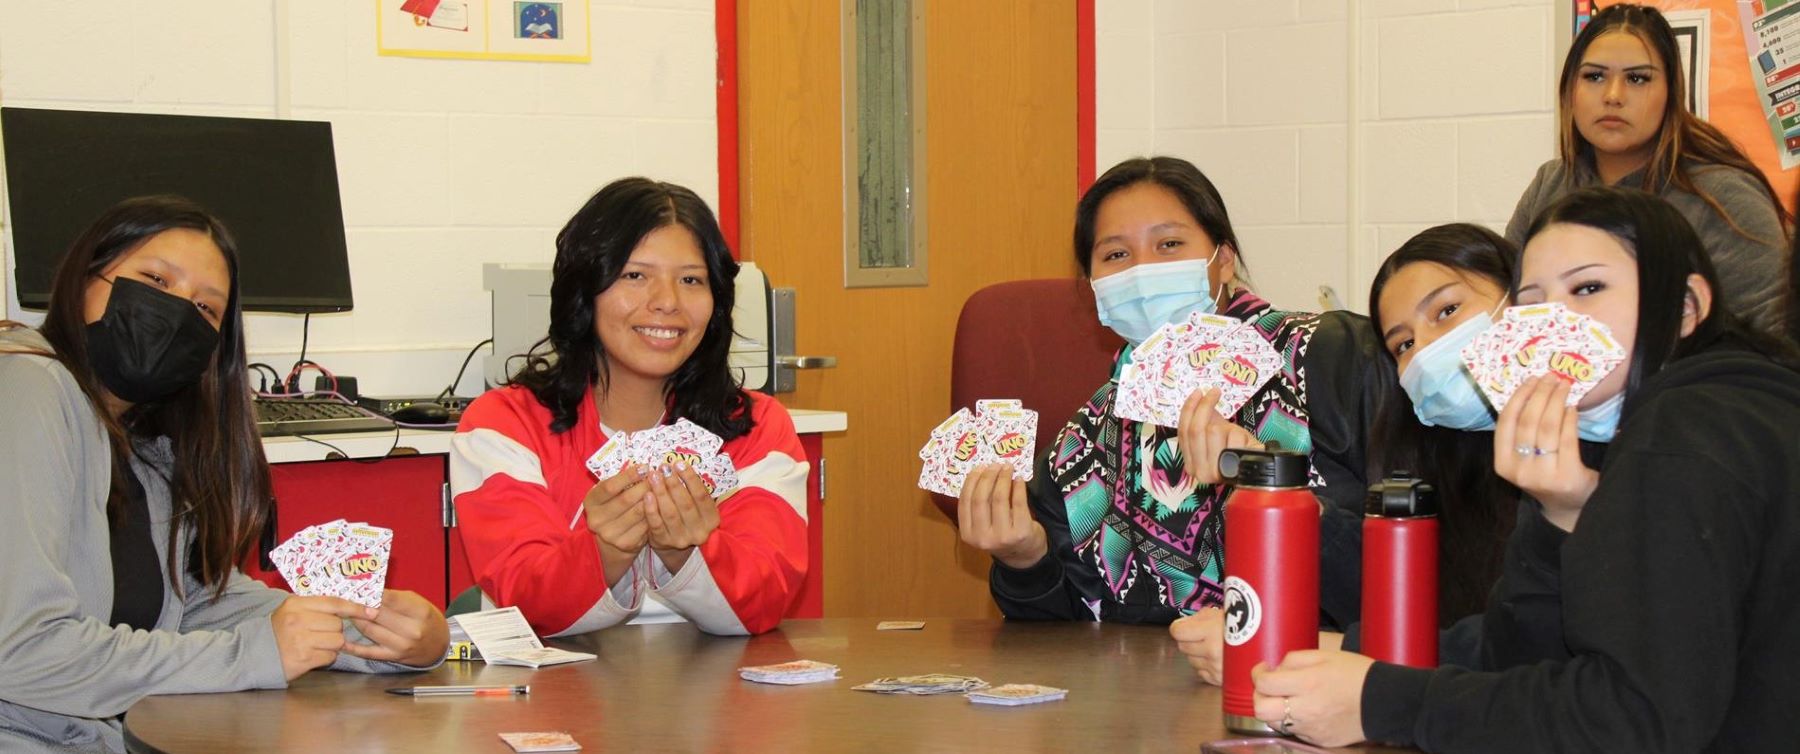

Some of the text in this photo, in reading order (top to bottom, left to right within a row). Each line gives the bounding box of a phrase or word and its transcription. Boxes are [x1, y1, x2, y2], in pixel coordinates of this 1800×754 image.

[1219, 357, 1258, 386] UNO
[1549, 351, 1596, 382] UNO
[992, 433, 1029, 456] UNO
[339, 556, 379, 577] UNO
